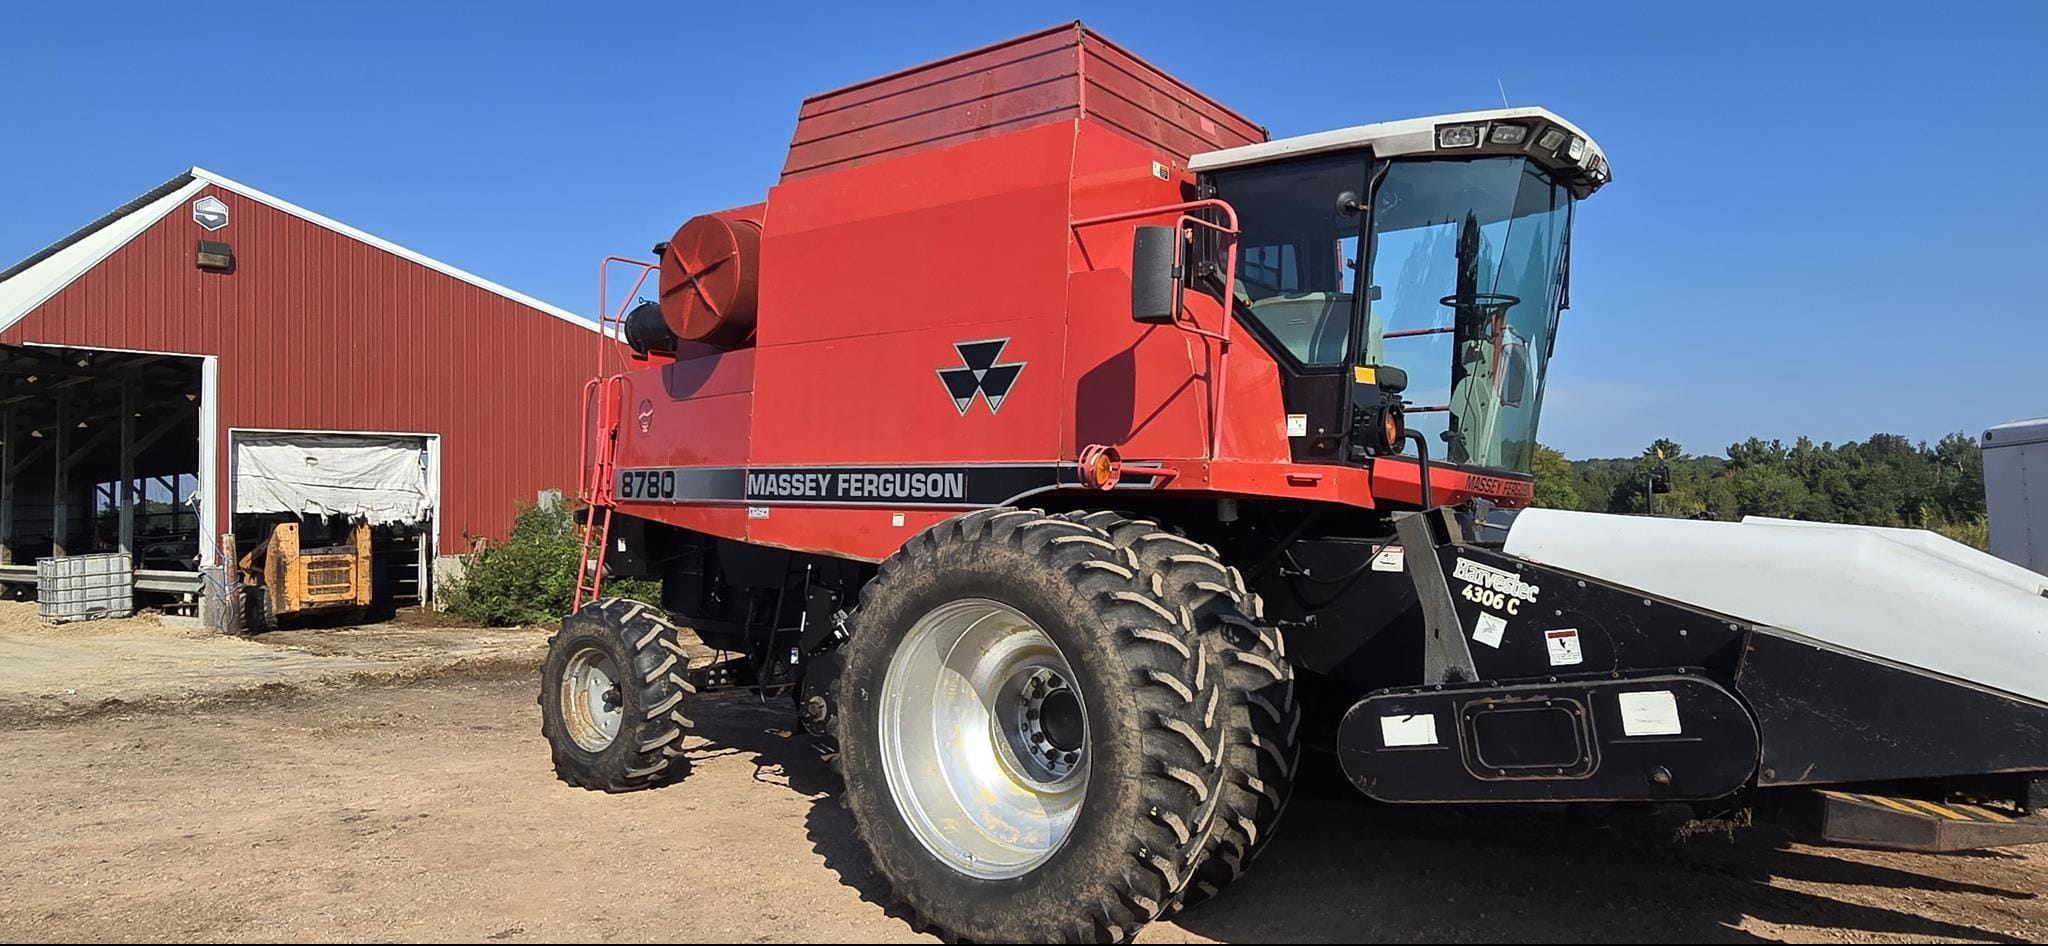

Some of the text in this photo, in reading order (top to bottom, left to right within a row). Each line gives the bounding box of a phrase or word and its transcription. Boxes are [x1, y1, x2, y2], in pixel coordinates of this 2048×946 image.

[622, 471, 675, 498] 8780
[748, 473, 963, 498] MASSEY FERGUSON
[1465, 475, 1533, 496] MASSEY FERGUS
[1452, 557, 1540, 603] Harvestec
[1461, 584, 1521, 616] 4306 C
